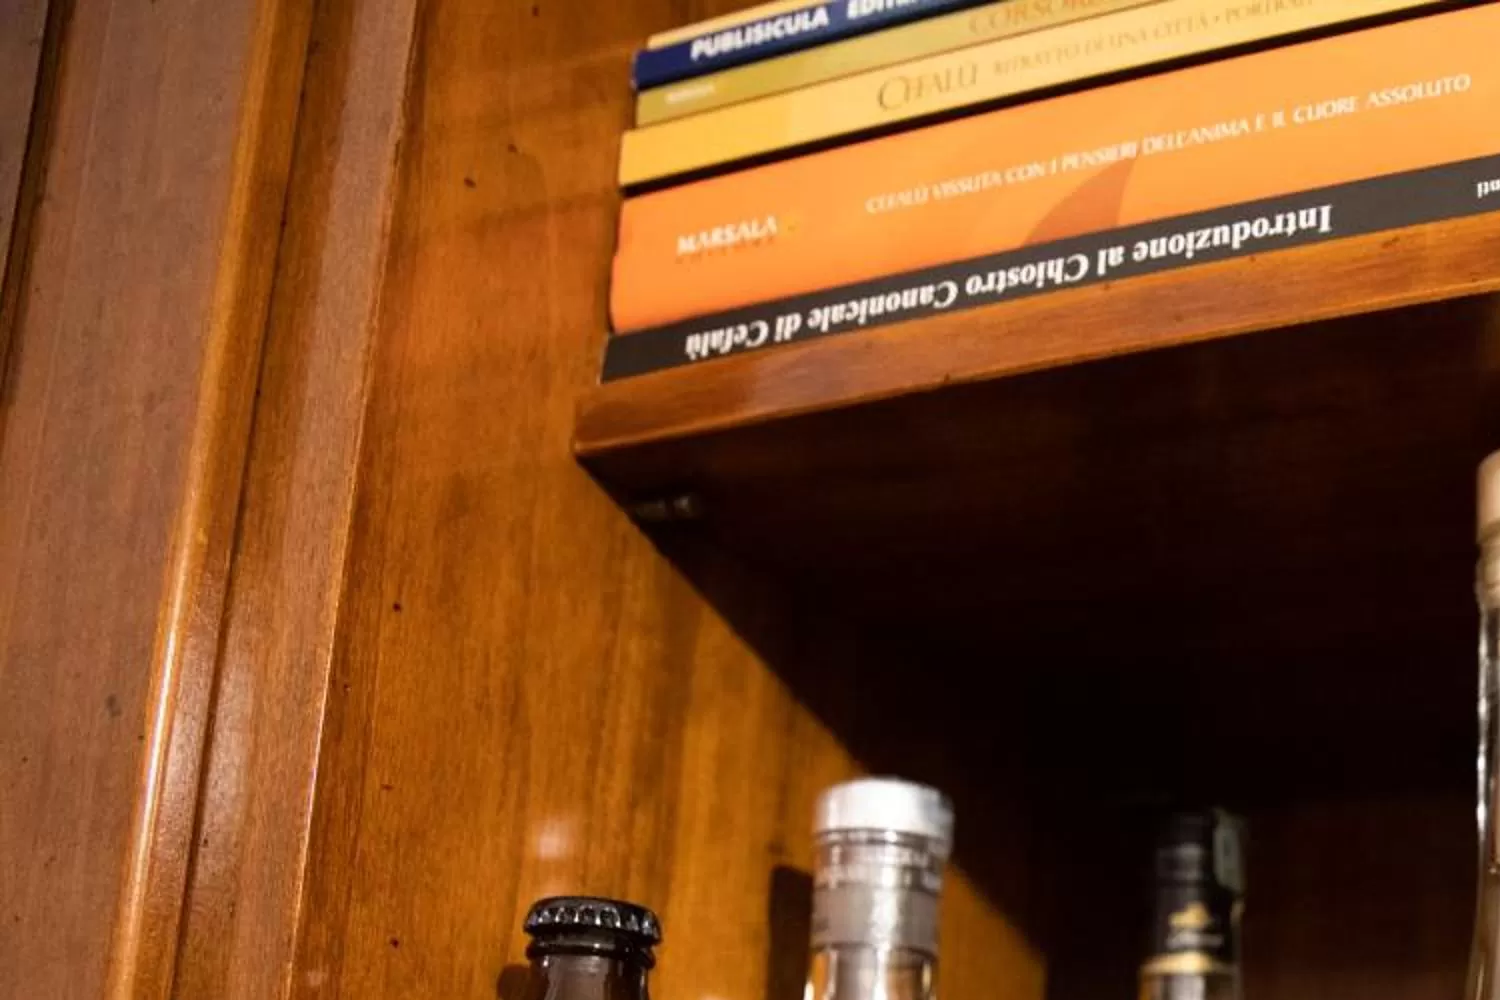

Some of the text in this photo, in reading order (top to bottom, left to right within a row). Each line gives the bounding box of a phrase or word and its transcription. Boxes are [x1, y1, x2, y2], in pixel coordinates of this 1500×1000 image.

[690, 7, 829, 62] PUBLISICULA
[931, 169, 1003, 199] VISSUTA
[1006, 161, 1046, 185] CON
[1061, 140, 1138, 170] PENSIERI
[1255, 113, 1266, 133] E
[1272, 109, 1286, 128] IL
[1293, 96, 1359, 125] CUORE
[1366, 73, 1472, 109] ASSOLUTO
[676, 215, 778, 256] MARSALA
[685, 203, 1333, 361] Introduzione al Chiostro Canonicale di Cefalù
